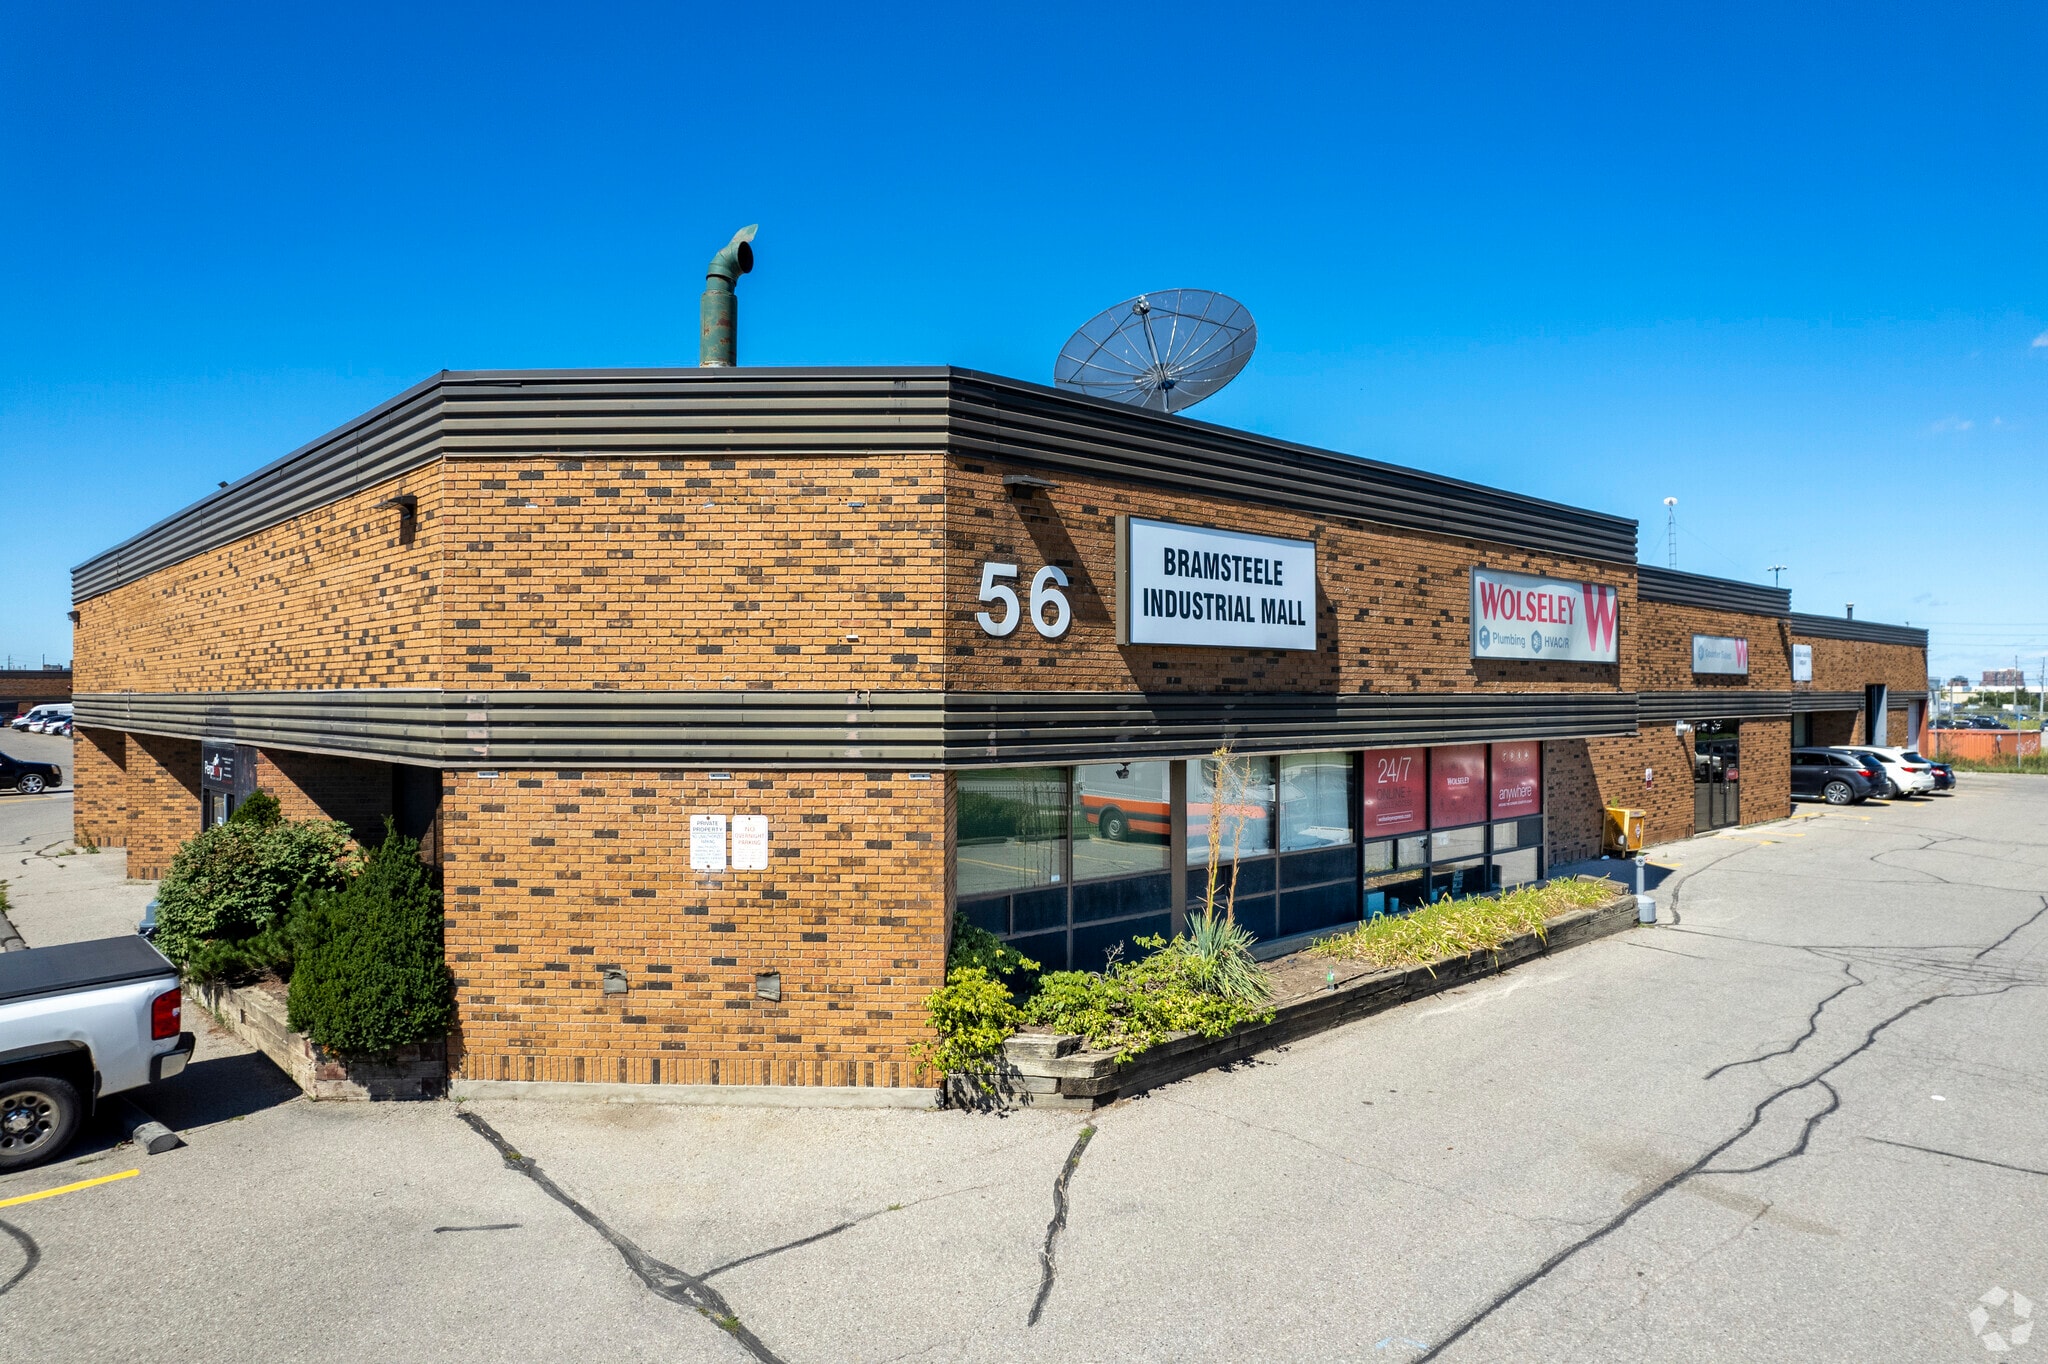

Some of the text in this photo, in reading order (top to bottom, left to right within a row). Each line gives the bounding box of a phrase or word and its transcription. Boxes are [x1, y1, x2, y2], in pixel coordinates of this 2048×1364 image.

[1163, 547, 1283, 587] BRAMSTEELE
[976, 562, 1072, 639] 56
[1143, 587, 1306, 626] INDUSTRIAL MALL
[1480, 582, 1576, 625] WOLSELEY
[1492, 632, 1526, 648] Plumbing
[1378, 756, 1412, 784] 24/7
[1499, 784, 1533, 802] anywhere
